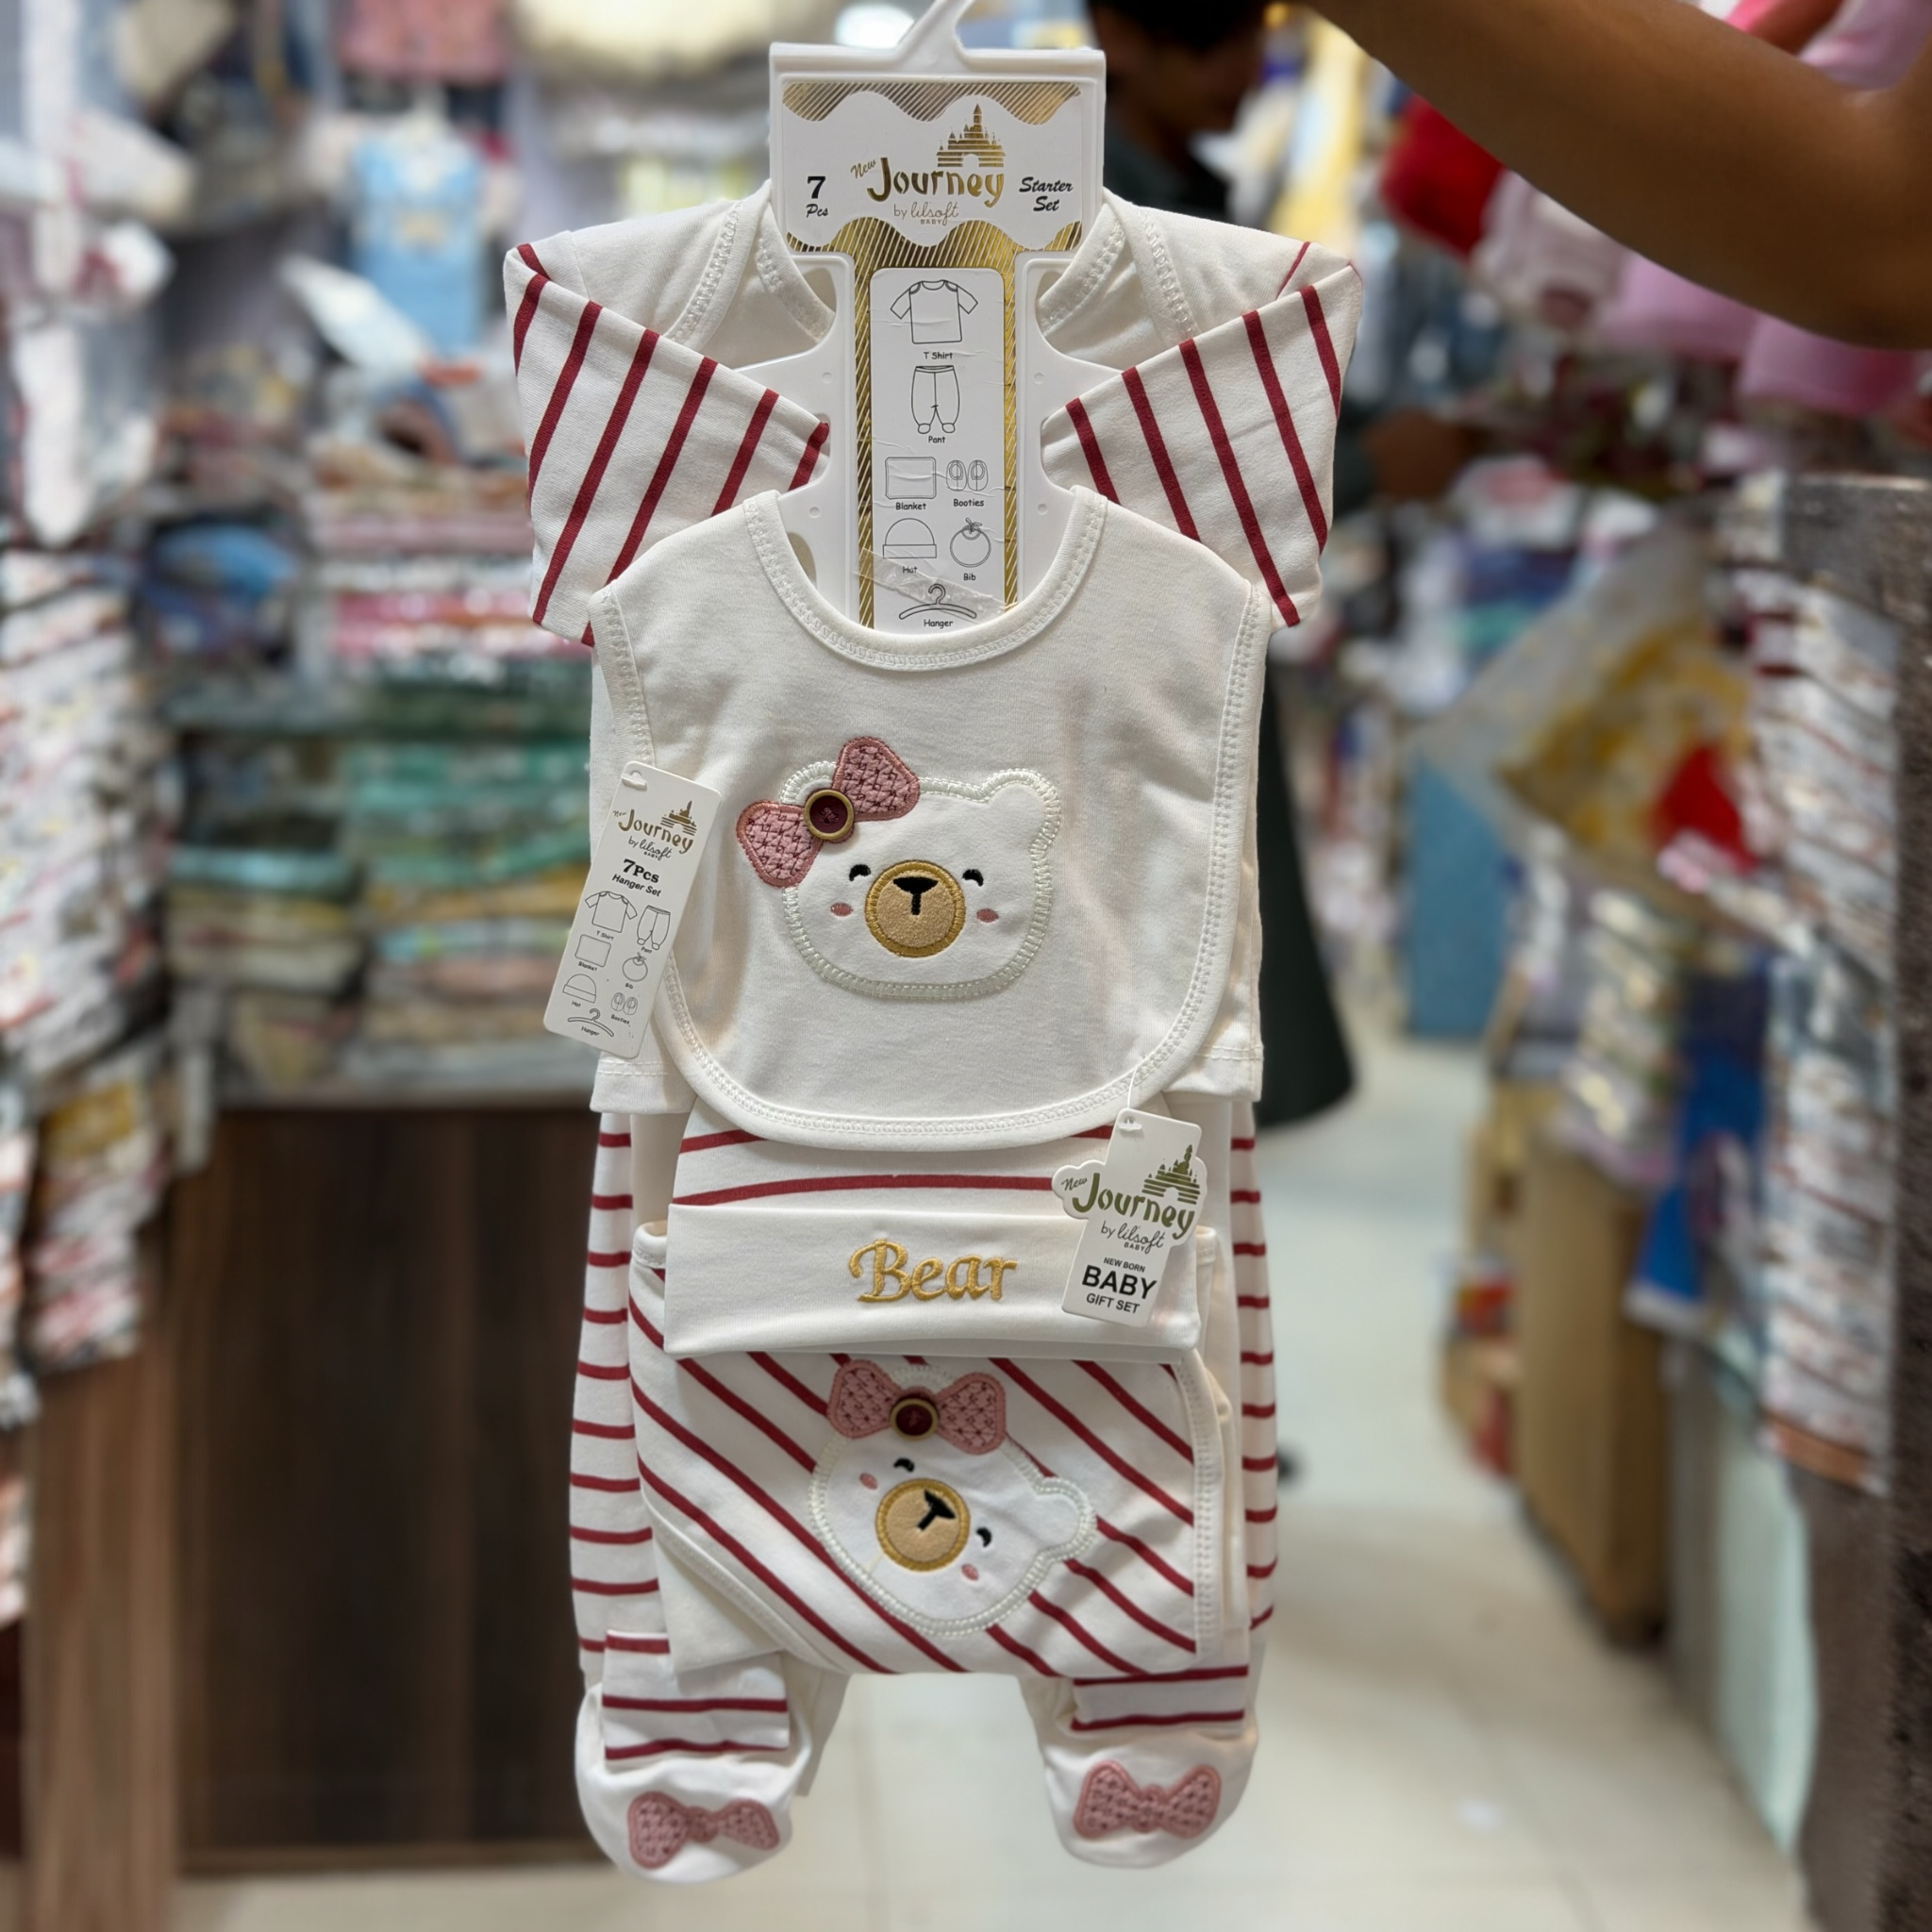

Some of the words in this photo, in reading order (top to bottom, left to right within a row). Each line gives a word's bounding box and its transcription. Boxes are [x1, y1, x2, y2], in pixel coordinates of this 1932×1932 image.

[851, 160, 876, 179] New
[807, 175, 826, 199] 7
[867, 157, 1005, 208] Journey
[1019, 176, 1074, 193] Starter
[806, 204, 828, 218] Pcs
[893, 204, 908, 220] by
[1033, 196, 1059, 212] Set
[931, 352, 953, 360] Shirt
[928, 436, 946, 444] Pant
[895, 502, 926, 510] Blanket
[924, 620, 954, 629] Hanger
[618, 809, 694, 855] Journey
[628, 836, 639, 848] by
[623, 858, 659, 883] 7Pcs
[611, 874, 645, 891] Hanger
[645, 886, 661, 897] Set
[601, 932, 614, 941] Shirt
[578, 960, 597, 972] Blanket
[1061, 1176, 1088, 1191] New
[1072, 1173, 1195, 1241] Journey
[1100, 1221, 1114, 1238] by
[1124, 1241, 1145, 1252] BABY
[849, 1238, 1017, 1303] Bear
[1103, 1257, 1123, 1268] NEW
[1123, 1260, 1145, 1273] BORN
[1081, 1265, 1158, 1300] BABY
[1086, 1292, 1114, 1308] GIFT
[1115, 1299, 1140, 1314] SET
